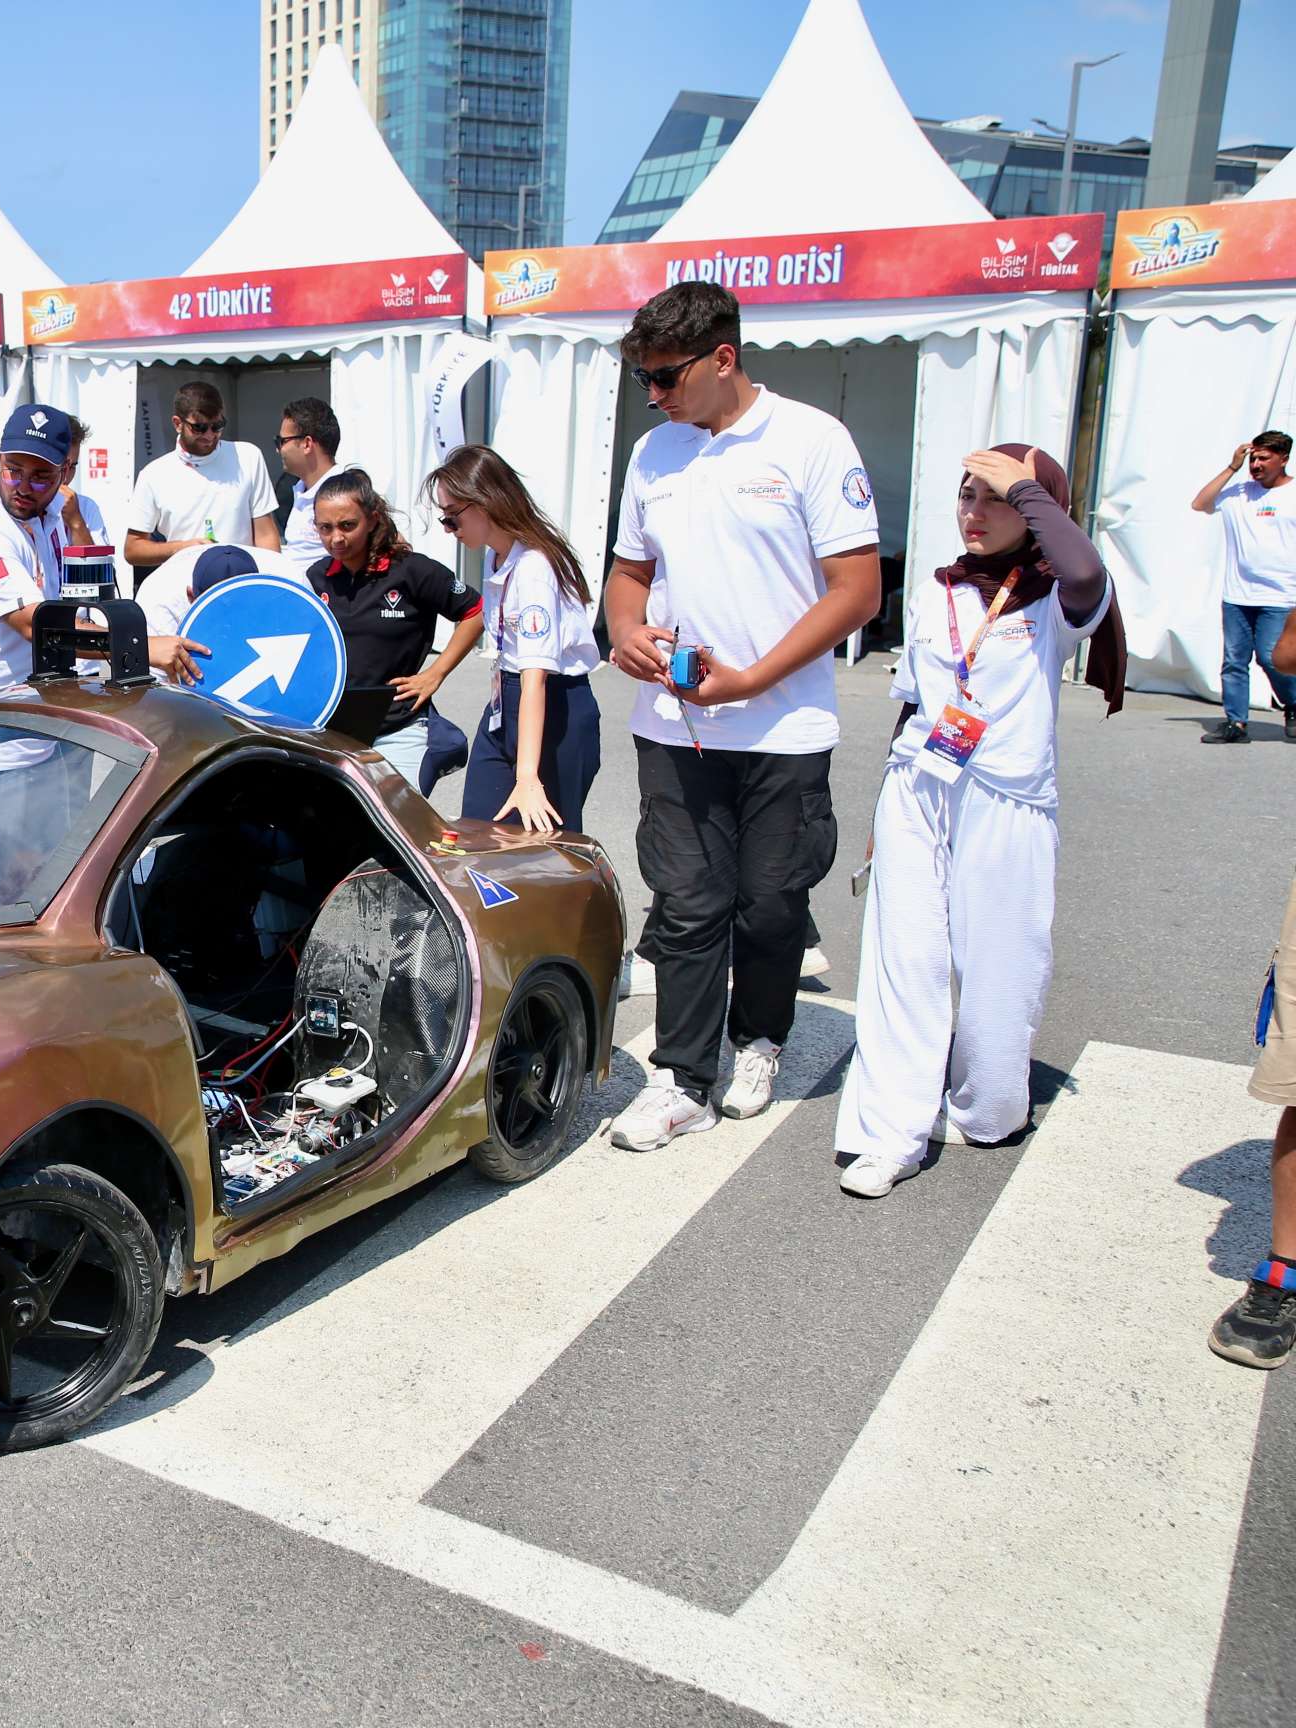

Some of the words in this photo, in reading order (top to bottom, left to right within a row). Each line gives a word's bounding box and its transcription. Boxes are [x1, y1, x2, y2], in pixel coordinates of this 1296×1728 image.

[666, 250, 770, 289] KARİYER
[777, 244, 843, 286] OFİSİ
[982, 266, 1025, 279] VADİSİ
[1040, 263, 1079, 276] TÜBİTAK
[1130, 240, 1219, 276] TEKNOFEST
[169, 293, 192, 320] 42
[196, 282, 272, 318] TÜRKİYE
[424, 293, 451, 305] TÜBİTAK
[495, 274, 556, 305] TEKNOFEST
